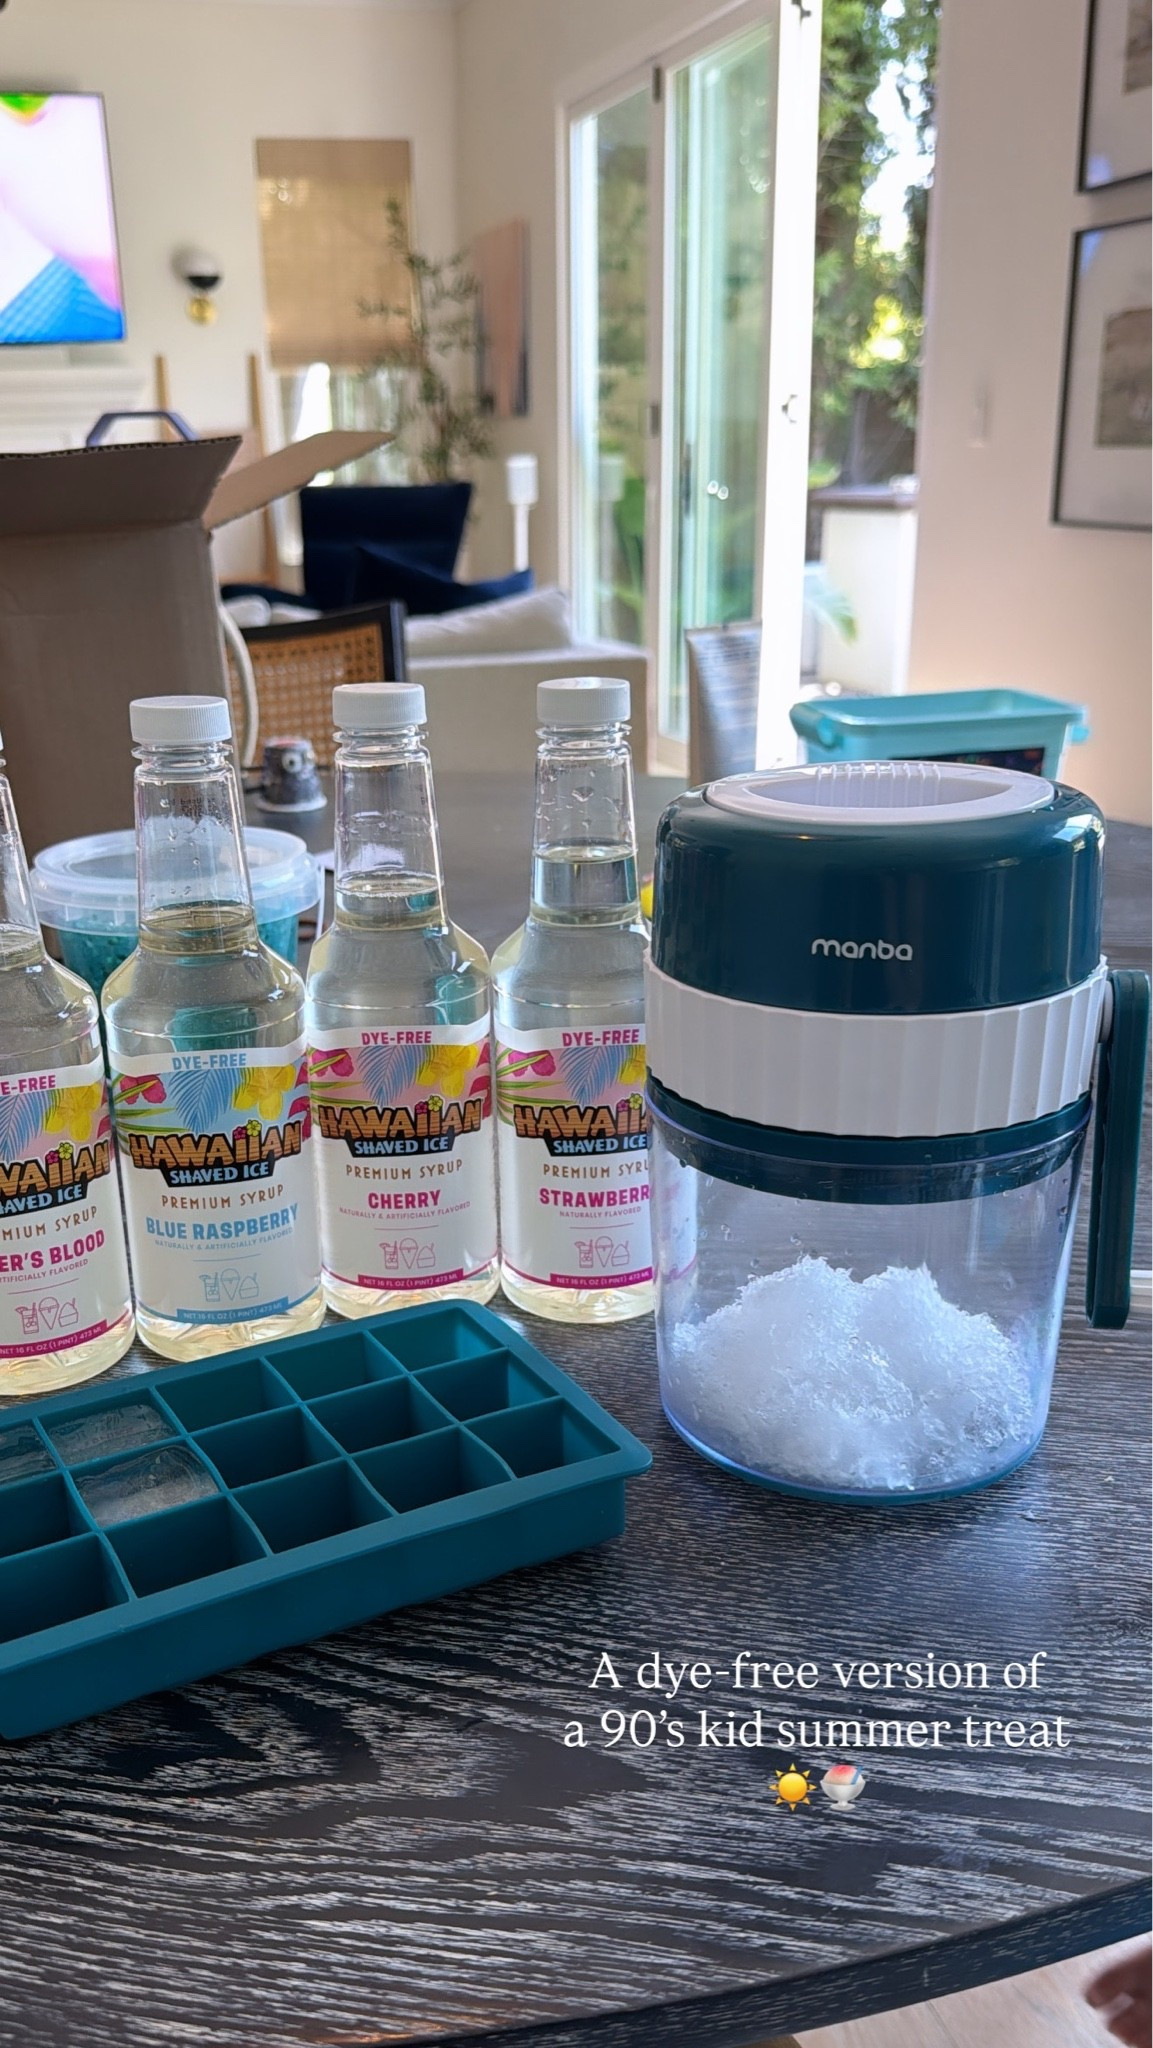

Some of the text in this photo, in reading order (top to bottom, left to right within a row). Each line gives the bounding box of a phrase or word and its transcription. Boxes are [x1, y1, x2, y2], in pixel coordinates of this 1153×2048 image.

[811, 938, 913, 961] manba
[361, 1030, 432, 1045] DYE-FREE
[562, 1029, 639, 1047] DYE-FREE
[172, 1053, 247, 1070] DYE-FREE
[514, 1093, 647, 1138] HAWAII
[354, 1136, 448, 1155] SHAVED ICE
[553, 1135, 647, 1153] SHAVED ICE
[170, 1161, 269, 1184] SHAVED ICE
[346, 1159, 463, 1180] PREMIUM SYRUP
[543, 1164, 610, 1179] PREMIUM
[57, 1183, 82, 1203] ICE
[161, 1184, 284, 1209] PREMIUM SYRUP
[368, 1189, 441, 1210] CHERRY
[539, 1184, 650, 1208] STRAWBERR
[55, 1205, 98, 1232] SYRUP
[339, 1207, 376, 1219] NATURALLY
[386, 1210, 435, 1219] ARTIFICIALLY
[437, 1201, 471, 1215] FLAVORED
[605, 1206, 641, 1217] FLAVORED
[146, 1203, 298, 1240] BLUE RASPBERRY
[49, 1229, 105, 1265] BLOOD
[155, 1239, 194, 1250] NATURALLY
[205, 1239, 257, 1251] ARTIFICIALLY
[259, 1227, 293, 1243] FLAVORED
[49, 1258, 88, 1276] FLAVORED
[80, 1331, 92, 1339] 473
